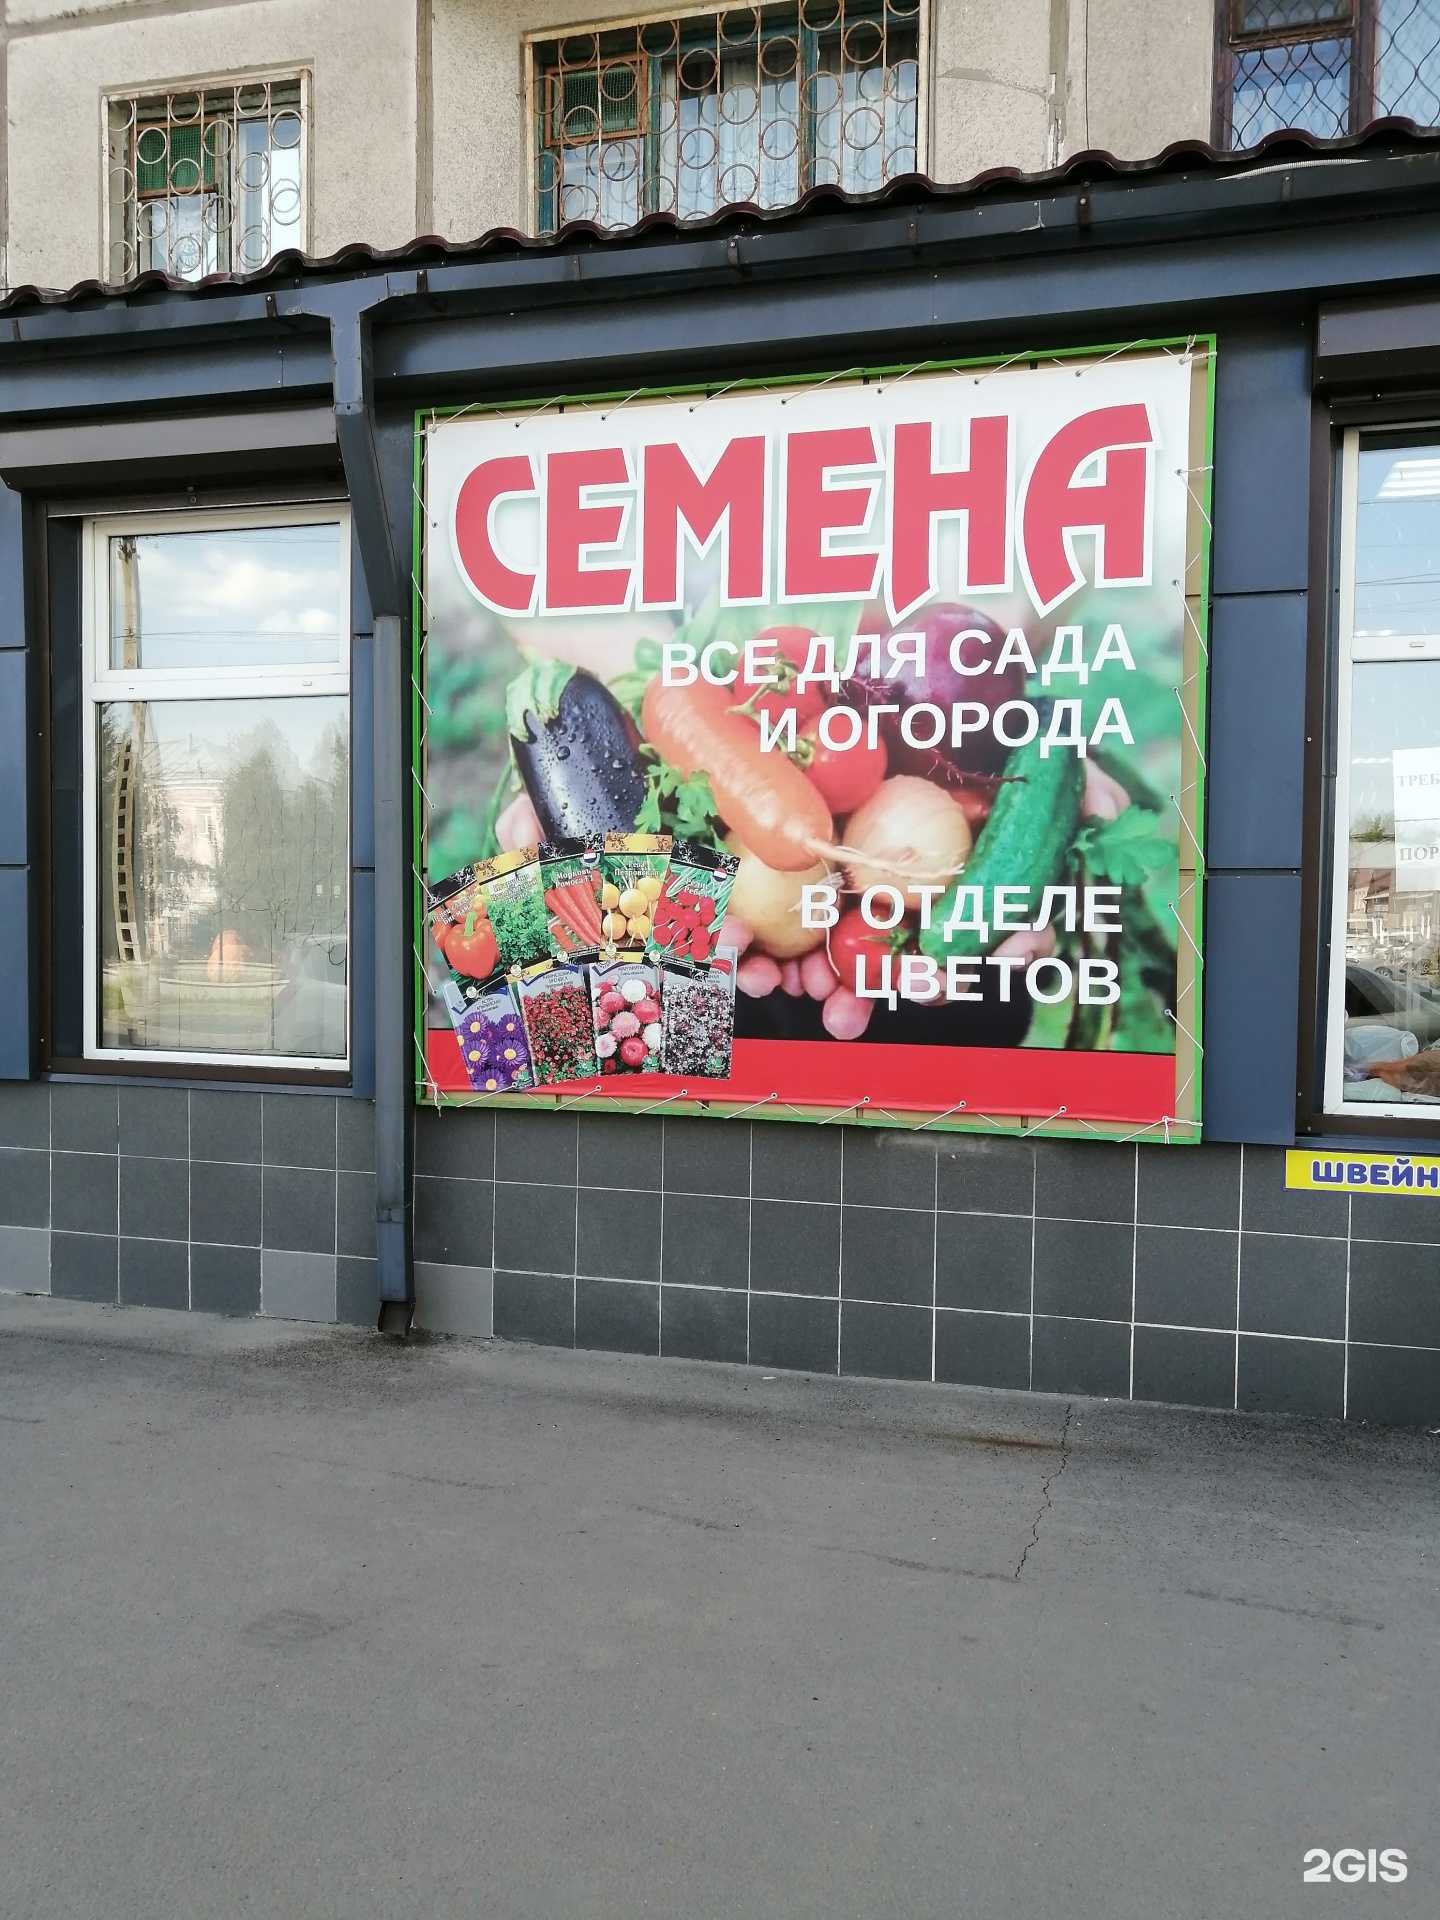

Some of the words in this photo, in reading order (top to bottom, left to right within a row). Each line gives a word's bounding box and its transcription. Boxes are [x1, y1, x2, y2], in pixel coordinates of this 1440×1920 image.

[453, 402, 1156, 616] СЕМЕНА
[660, 638, 779, 687] ВСЕ
[796, 631, 927, 695] ДЛЯ
[949, 623, 1137, 687] САДА
[759, 707, 797, 753] И
[818, 697, 1136, 759] ОГОРОДА
[801, 884, 840, 929] В
[860, 884, 1123, 943] ОТДЕЛЕ
[855, 954, 1121, 1011] ЦВЕТОВ
[1312, 1158, 1439, 1189] ШВЕЙН
